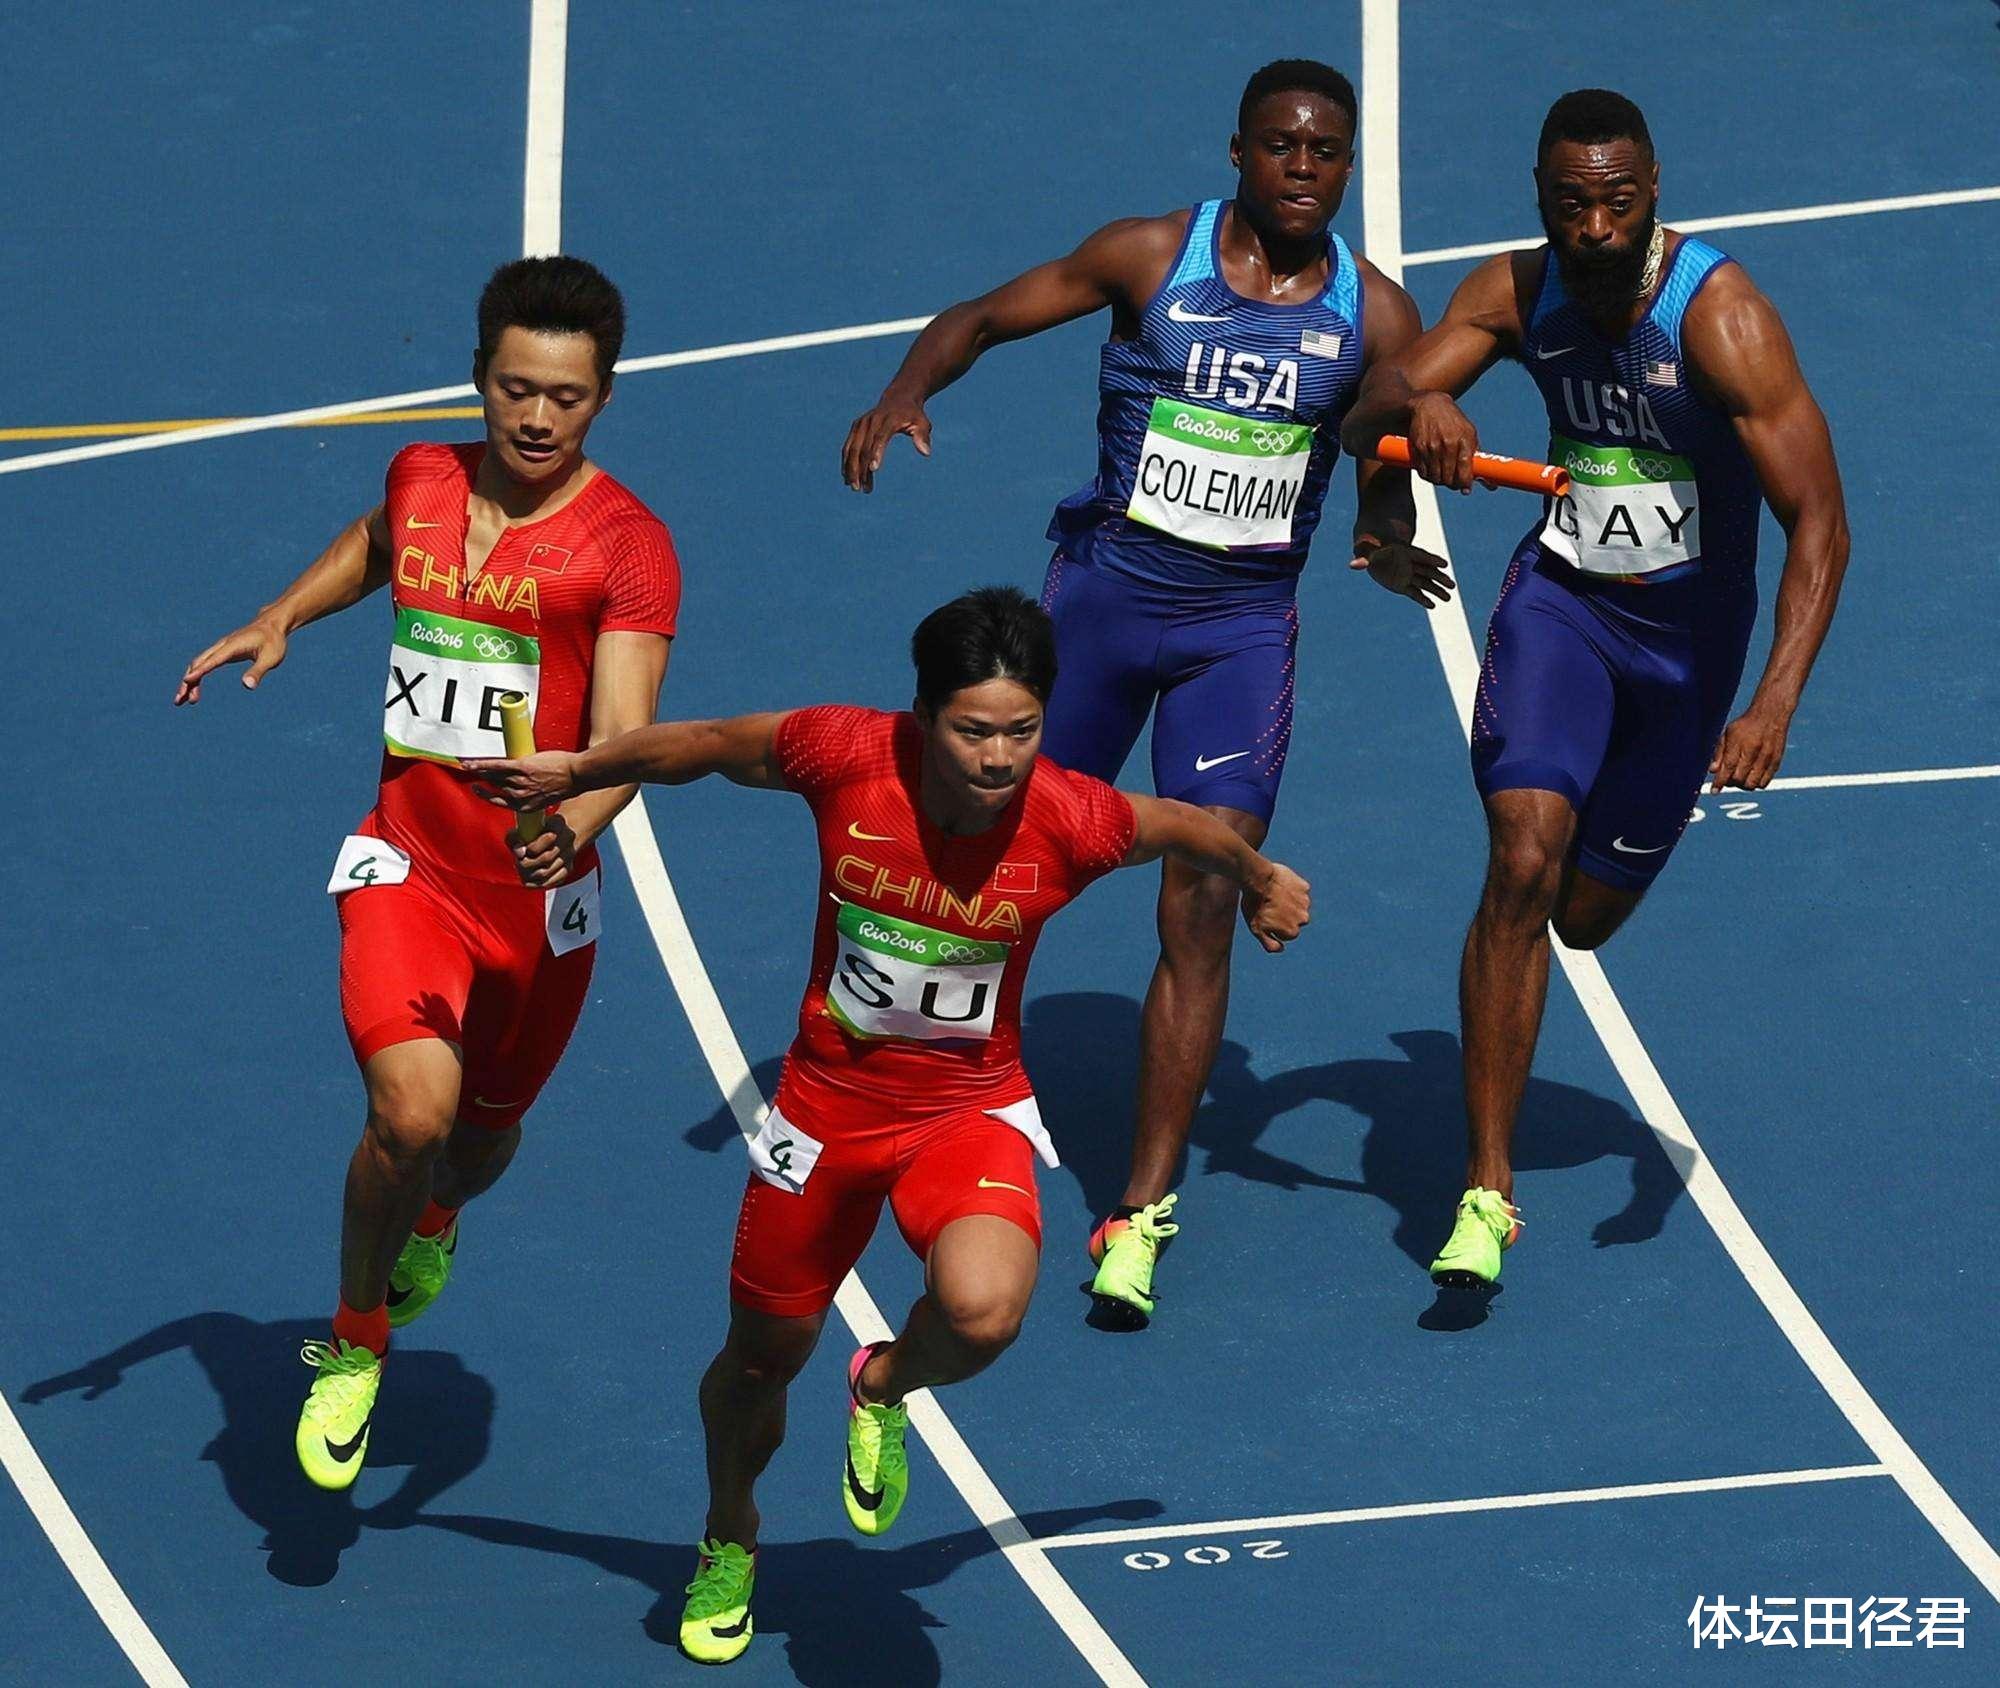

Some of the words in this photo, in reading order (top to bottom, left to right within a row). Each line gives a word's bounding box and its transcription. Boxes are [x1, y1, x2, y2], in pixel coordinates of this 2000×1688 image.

[1184, 342, 1298, 412] USA
[1173, 413, 1240, 444] Rio2016
[1562, 377, 1672, 450] USA
[1565, 451, 1618, 476] Rio2016
[1141, 453, 1298, 520] COLEMAN
[1554, 494, 1696, 547] GAY
[410, 622, 464, 649] Rio2016
[349, 856, 379, 887] 4
[835, 854, 1022, 935] CHINA
[562, 897, 589, 935] 4
[858, 921, 927, 954] Rio2016
[839, 953, 989, 1021] SU
[770, 1139, 793, 1174] 4
[1123, 1540, 1290, 1570] 200
